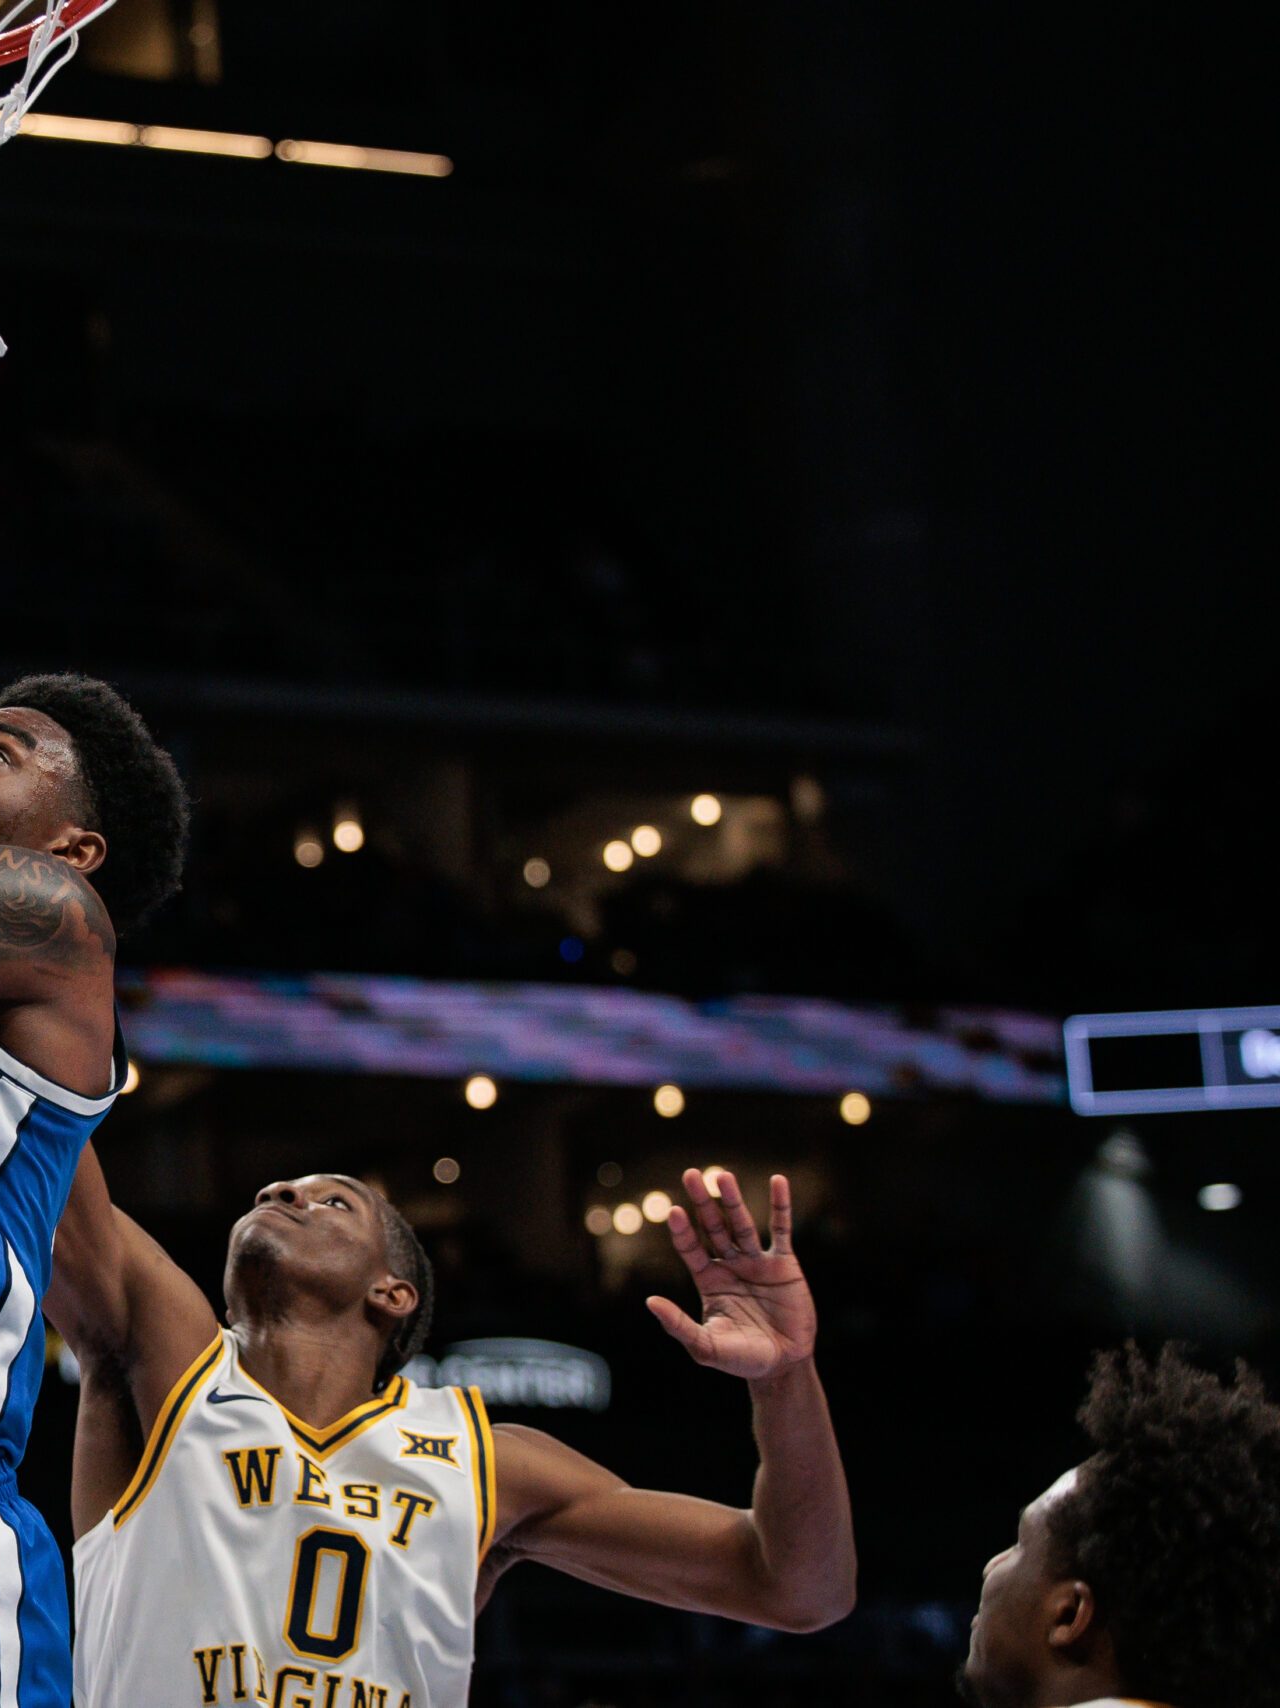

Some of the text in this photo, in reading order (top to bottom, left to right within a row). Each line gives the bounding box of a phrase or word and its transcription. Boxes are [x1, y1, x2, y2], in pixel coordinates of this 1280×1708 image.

[222, 1446, 436, 1549] WEST
[398, 1427, 462, 1470] XII
[282, 1524, 371, 1664] 0
